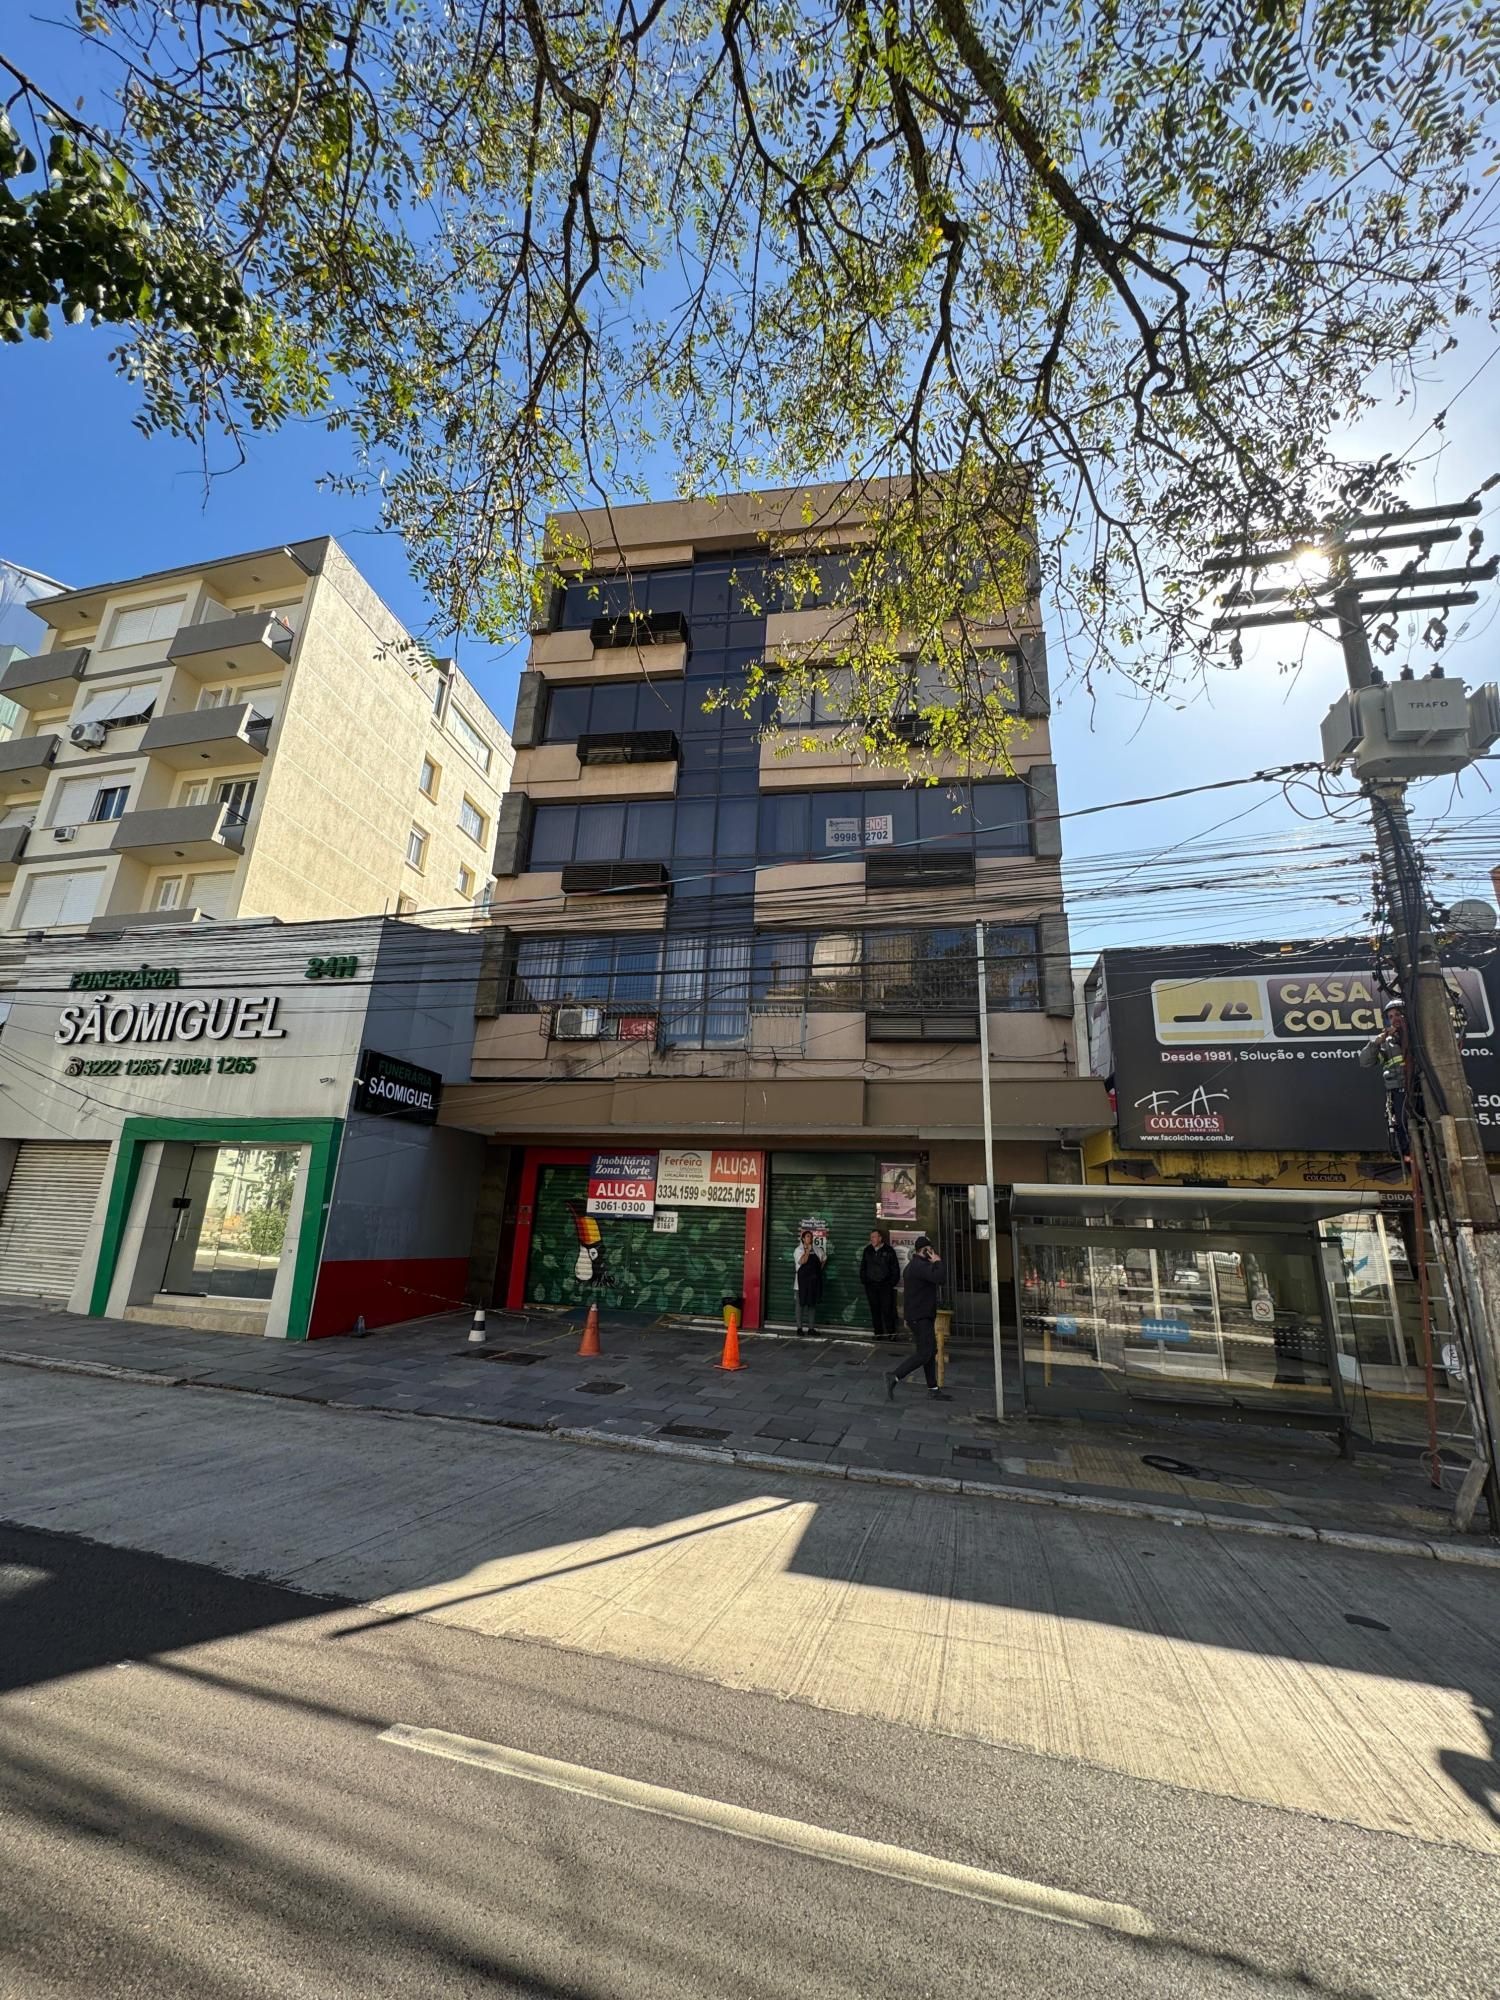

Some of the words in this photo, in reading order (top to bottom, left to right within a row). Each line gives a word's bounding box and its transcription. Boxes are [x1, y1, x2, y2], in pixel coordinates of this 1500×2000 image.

[861, 817, 888, 831] ENDE
[304, 955, 359, 978] 24H
[70, 964, 180, 991] FUNERÁRIA
[1280, 981, 1373, 1004] CASA
[1161, 1052, 1201, 1062] Desde
[1240, 1049, 1293, 1062] Solução
[1297, 1051, 1305, 1059] e
[1311, 1049, 1362, 1060] confort
[1461, 1048, 1493, 1056] ono.
[83, 1059, 123, 1076] 3222
[215, 1057, 258, 1075] 1265
[378, 1060, 433, 1087] FUNERÁRIA
[368, 1075, 435, 1110] SÃOMIGUEL
[1150, 1115, 1219, 1129] COLCHÕES
[1140, 1134, 1234, 1142] www.facolchoes.com.br
[596, 1155, 651, 1166] Imobiliária
[664, 1156, 702, 1166] Ferreira
[715, 1157, 757, 1176] ALUGA
[595, 1165, 620, 1175] Zona
[622, 1165, 650, 1175] Norte
[596, 1183, 647, 1197] ALUGA
[657, 1185, 699, 1200] 3334.1599
[707, 1186, 755, 1203] 98225.0155
[1380, 1193, 1416, 1201] EDIDA
[595, 1201, 646, 1212] 3061-0300
[814, 1238, 824, 1246] 61
